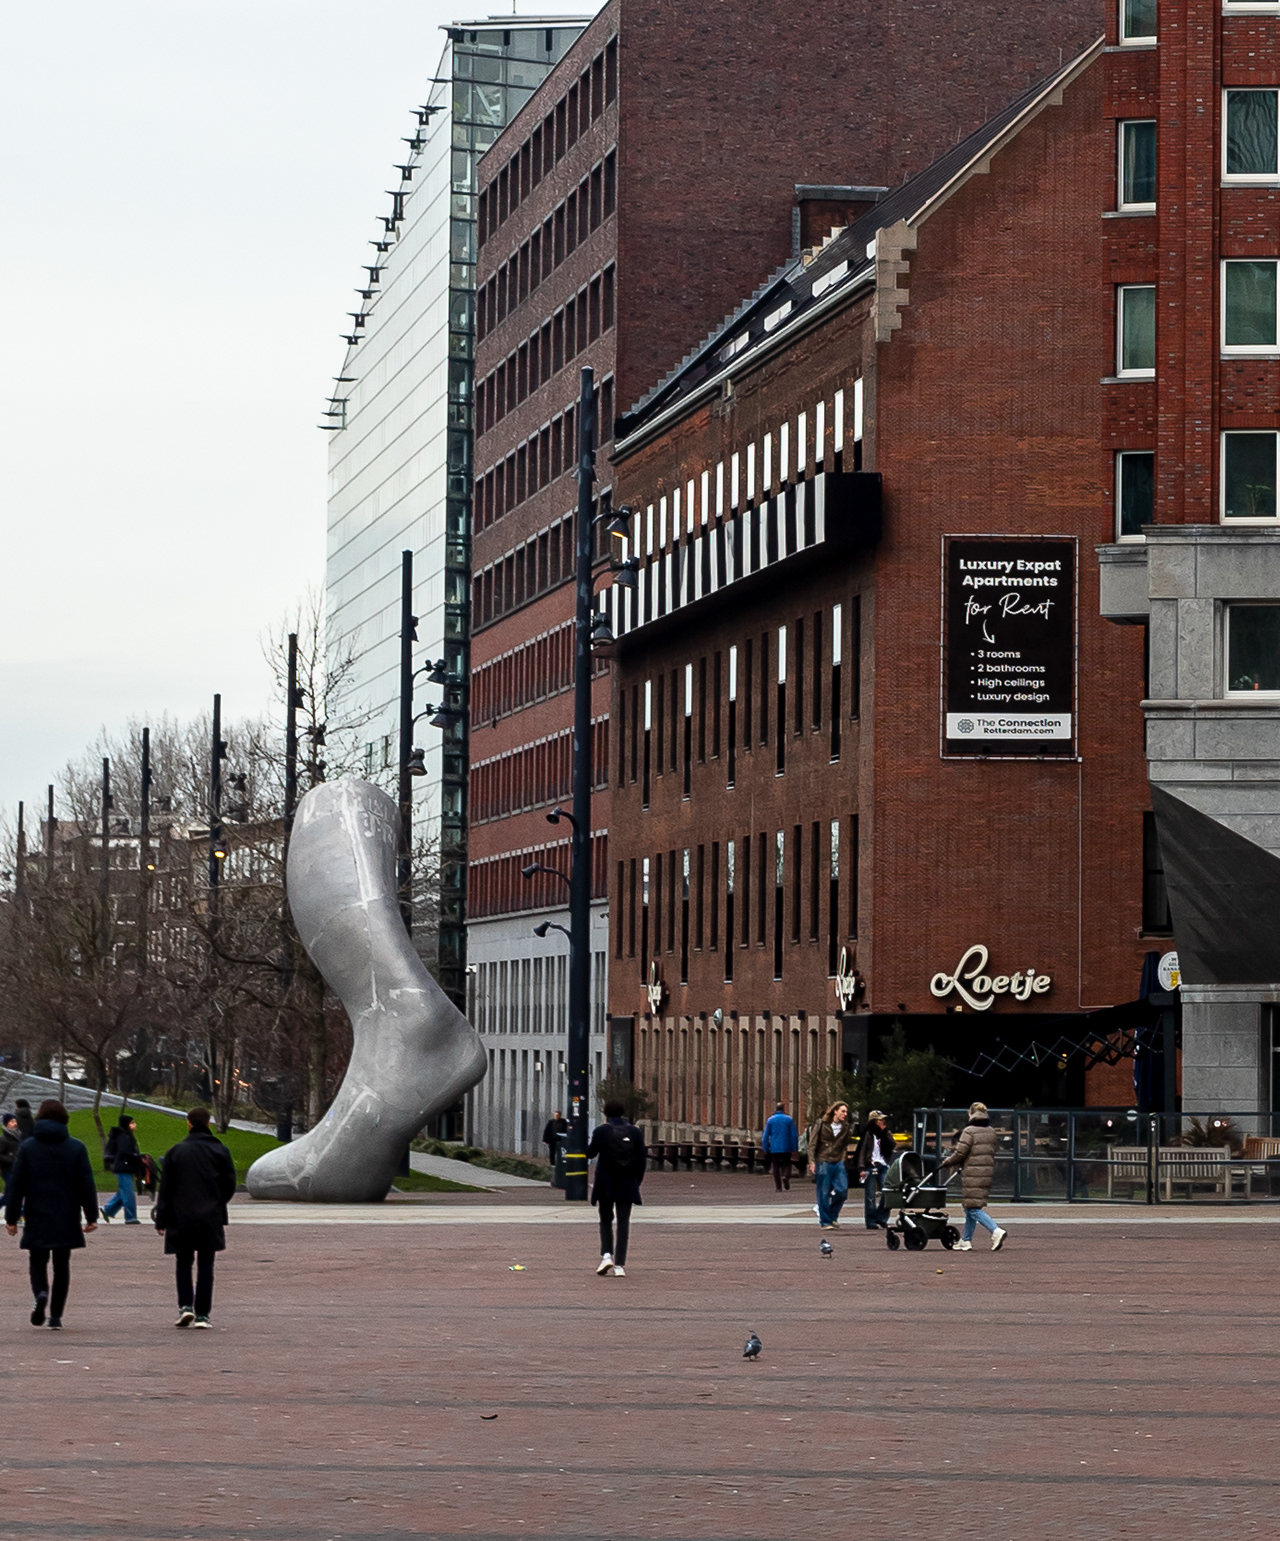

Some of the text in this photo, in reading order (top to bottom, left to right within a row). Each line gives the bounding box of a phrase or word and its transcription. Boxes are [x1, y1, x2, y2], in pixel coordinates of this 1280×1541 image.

[959, 558, 1062, 574] Luxury Expat
[962, 574, 1058, 590] Apartments
[964, 592, 1056, 625] for Rent
[977, 649, 1021, 659] 3 rooms
[977, 664, 1046, 673] 2 bathrooms
[977, 678, 1046, 689] High ceilings
[977, 692, 1050, 703] Luxury design
[977, 718, 1062, 727] The Connection
[983, 727, 1054, 735] Rotterdam.com
[930, 944, 1051, 1012] Loetje
